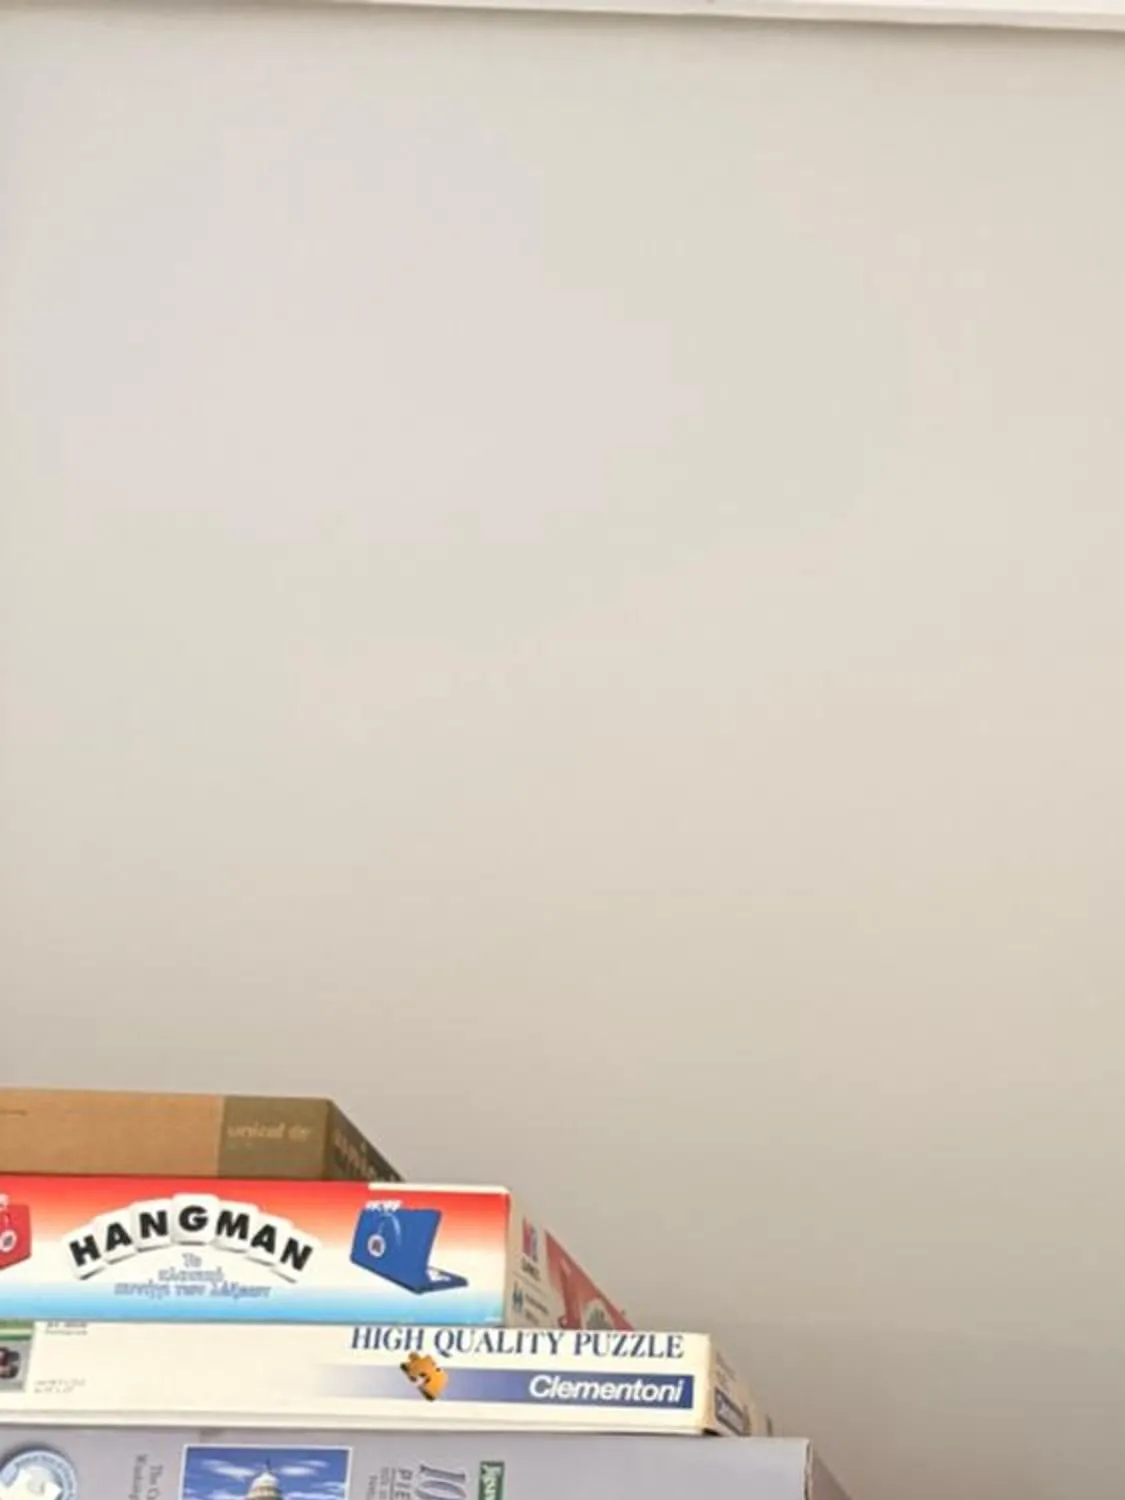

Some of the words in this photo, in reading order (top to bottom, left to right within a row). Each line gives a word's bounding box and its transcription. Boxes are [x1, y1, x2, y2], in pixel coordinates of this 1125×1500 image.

[69, 1205, 314, 1273] HANGMAN
[351, 1327, 425, 1351] HIGH
[433, 1329, 565, 1359] QUALITY
[573, 1331, 684, 1359] PUZZLE
[529, 1373, 685, 1403] Clementoni
